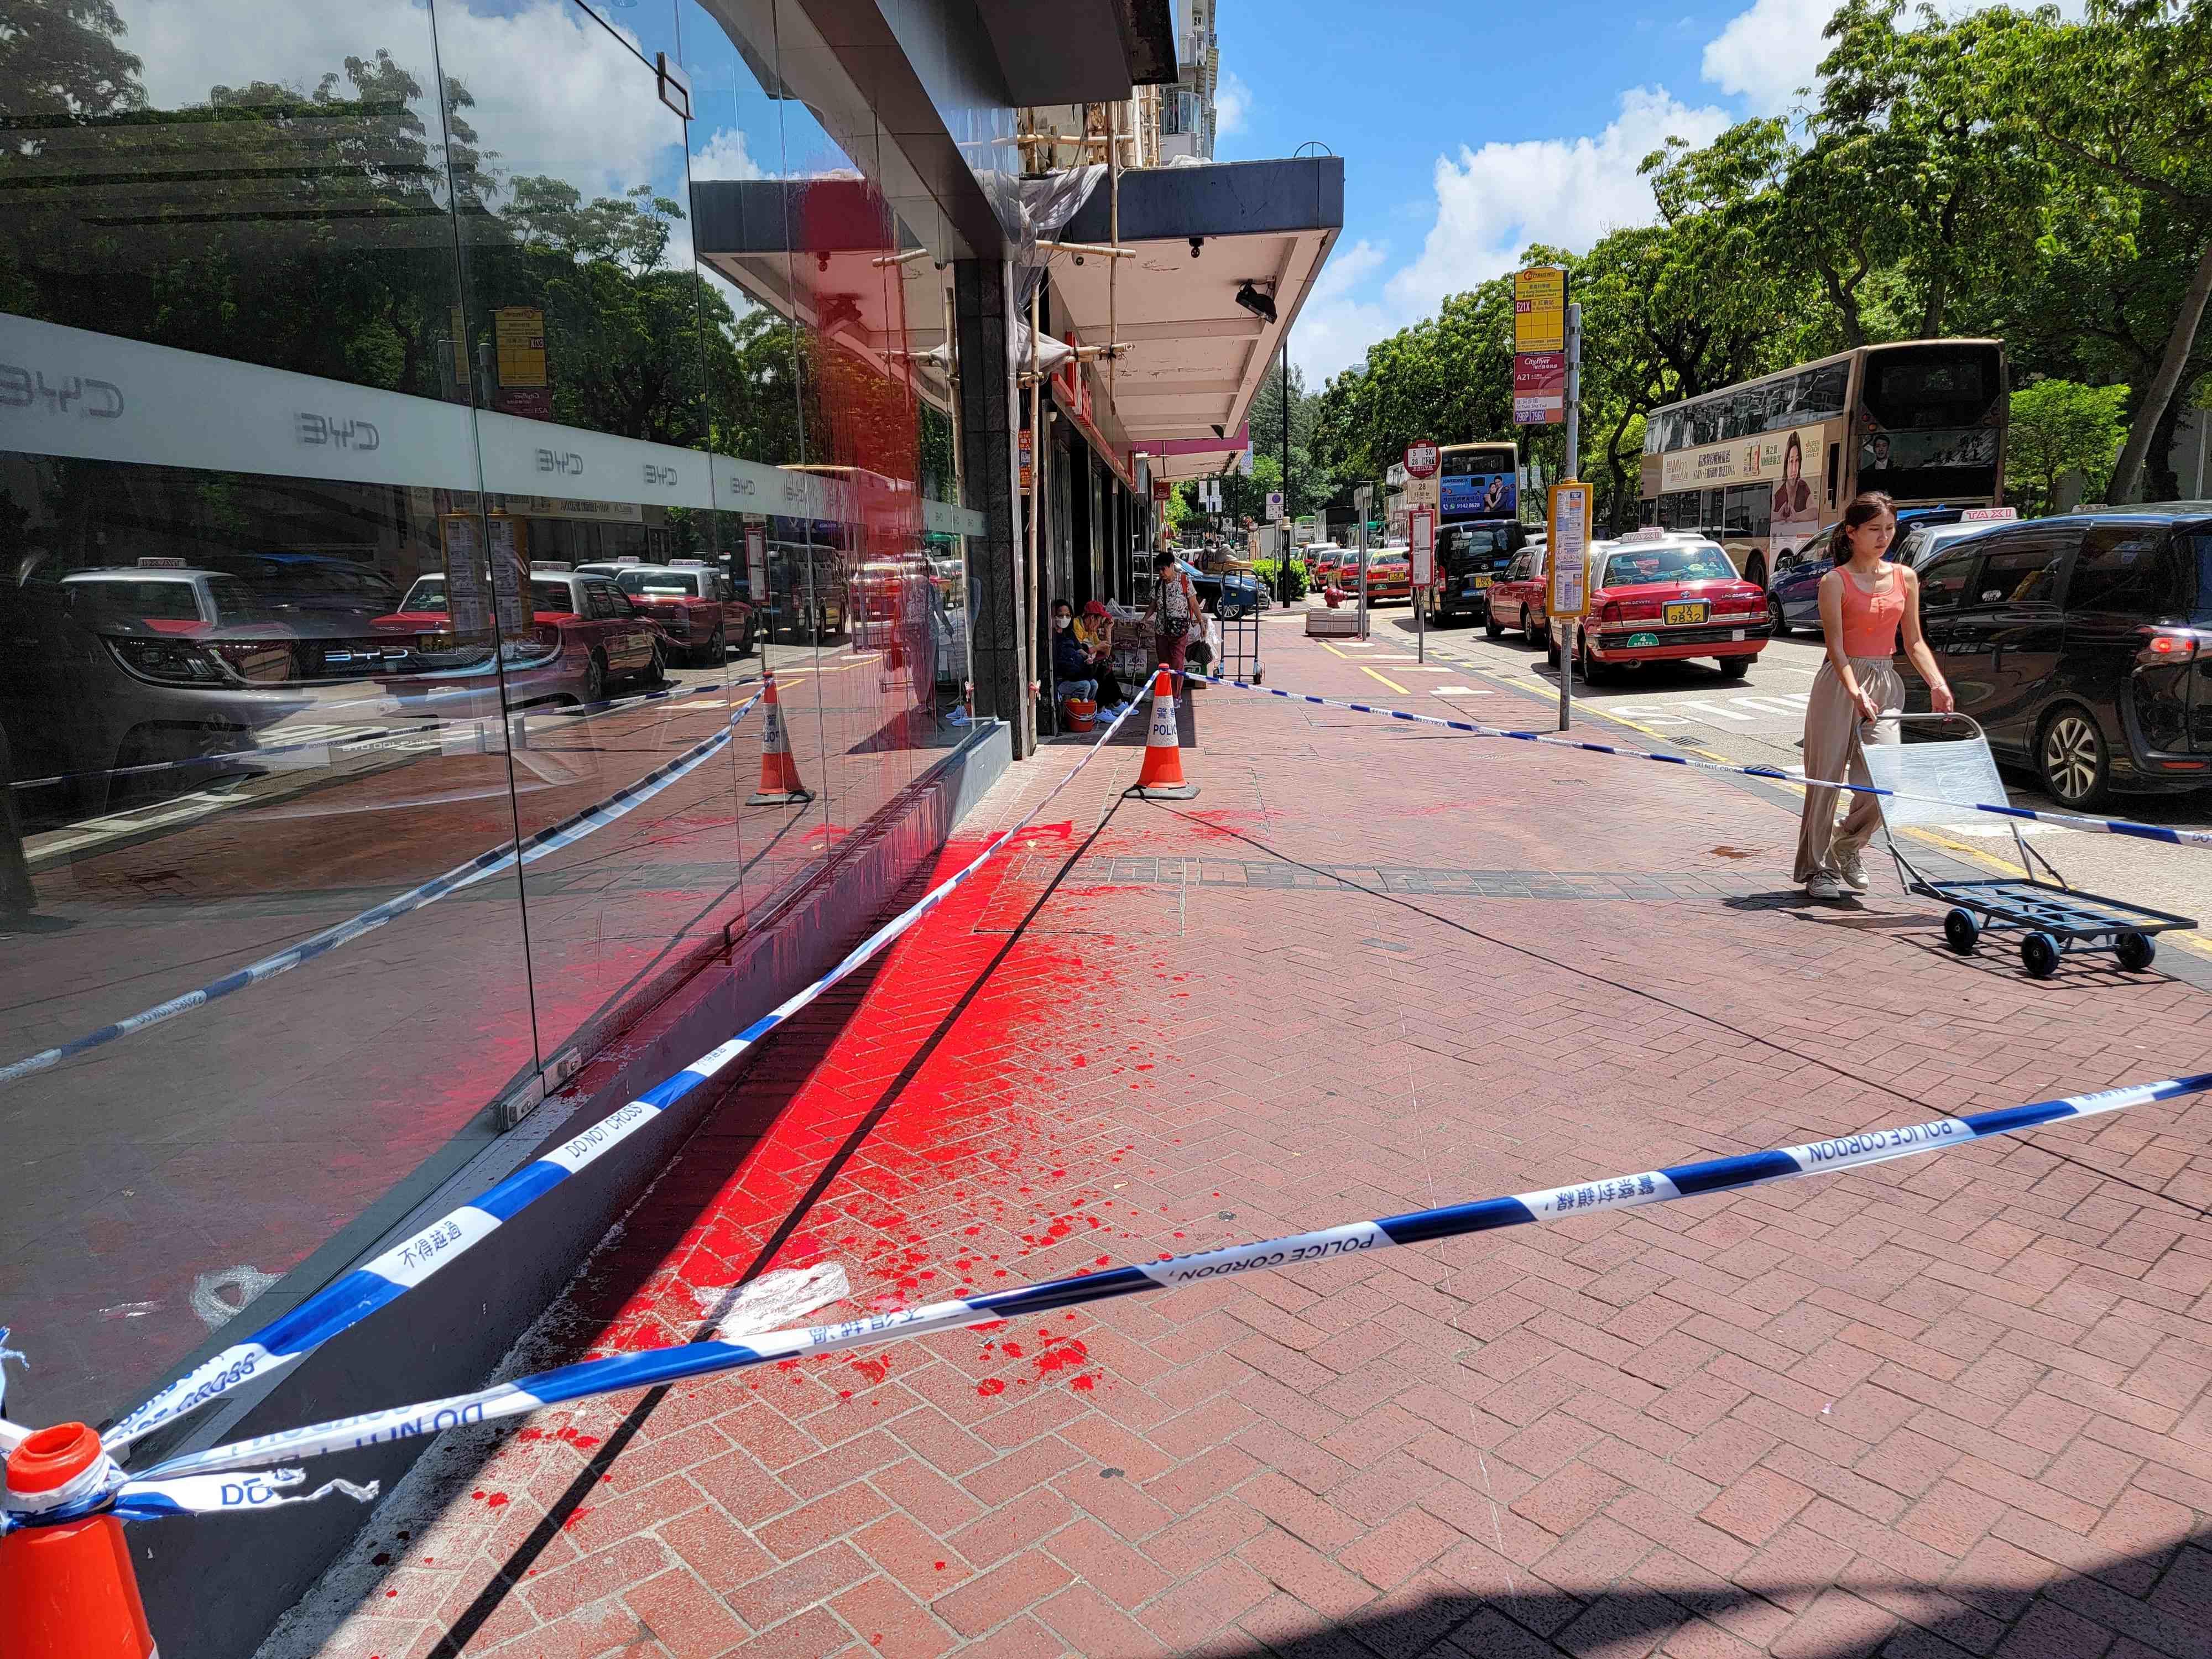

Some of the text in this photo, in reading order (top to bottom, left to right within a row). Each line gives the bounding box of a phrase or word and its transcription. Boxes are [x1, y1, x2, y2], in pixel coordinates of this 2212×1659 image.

[1516, 301, 1530, 312] E21X
[0, 365, 124, 419] BYD
[1516, 410, 1545, 422] 796P 796X
[298, 411, 380, 451] BYD
[538, 448, 583, 475] BYD
[644, 465, 678, 486] BYD
[732, 477, 756, 495] BYD
[1966, 509, 2012, 519] TAXI
[1626, 532, 1661, 540] TAXI
[1671, 613, 1701, 623] 9832
[1678, 605, 1693, 614] JX
[1608, 693, 1809, 725] STO
[1705, 763, 1719, 771] NOT
[565, 1104, 643, 1159] DO NOT CROSS
[1891, 1120, 1953, 1145] POLICE
[397, 1220, 463, 1270] 不得越過
[1292, 1233, 1375, 1261] POLICE
